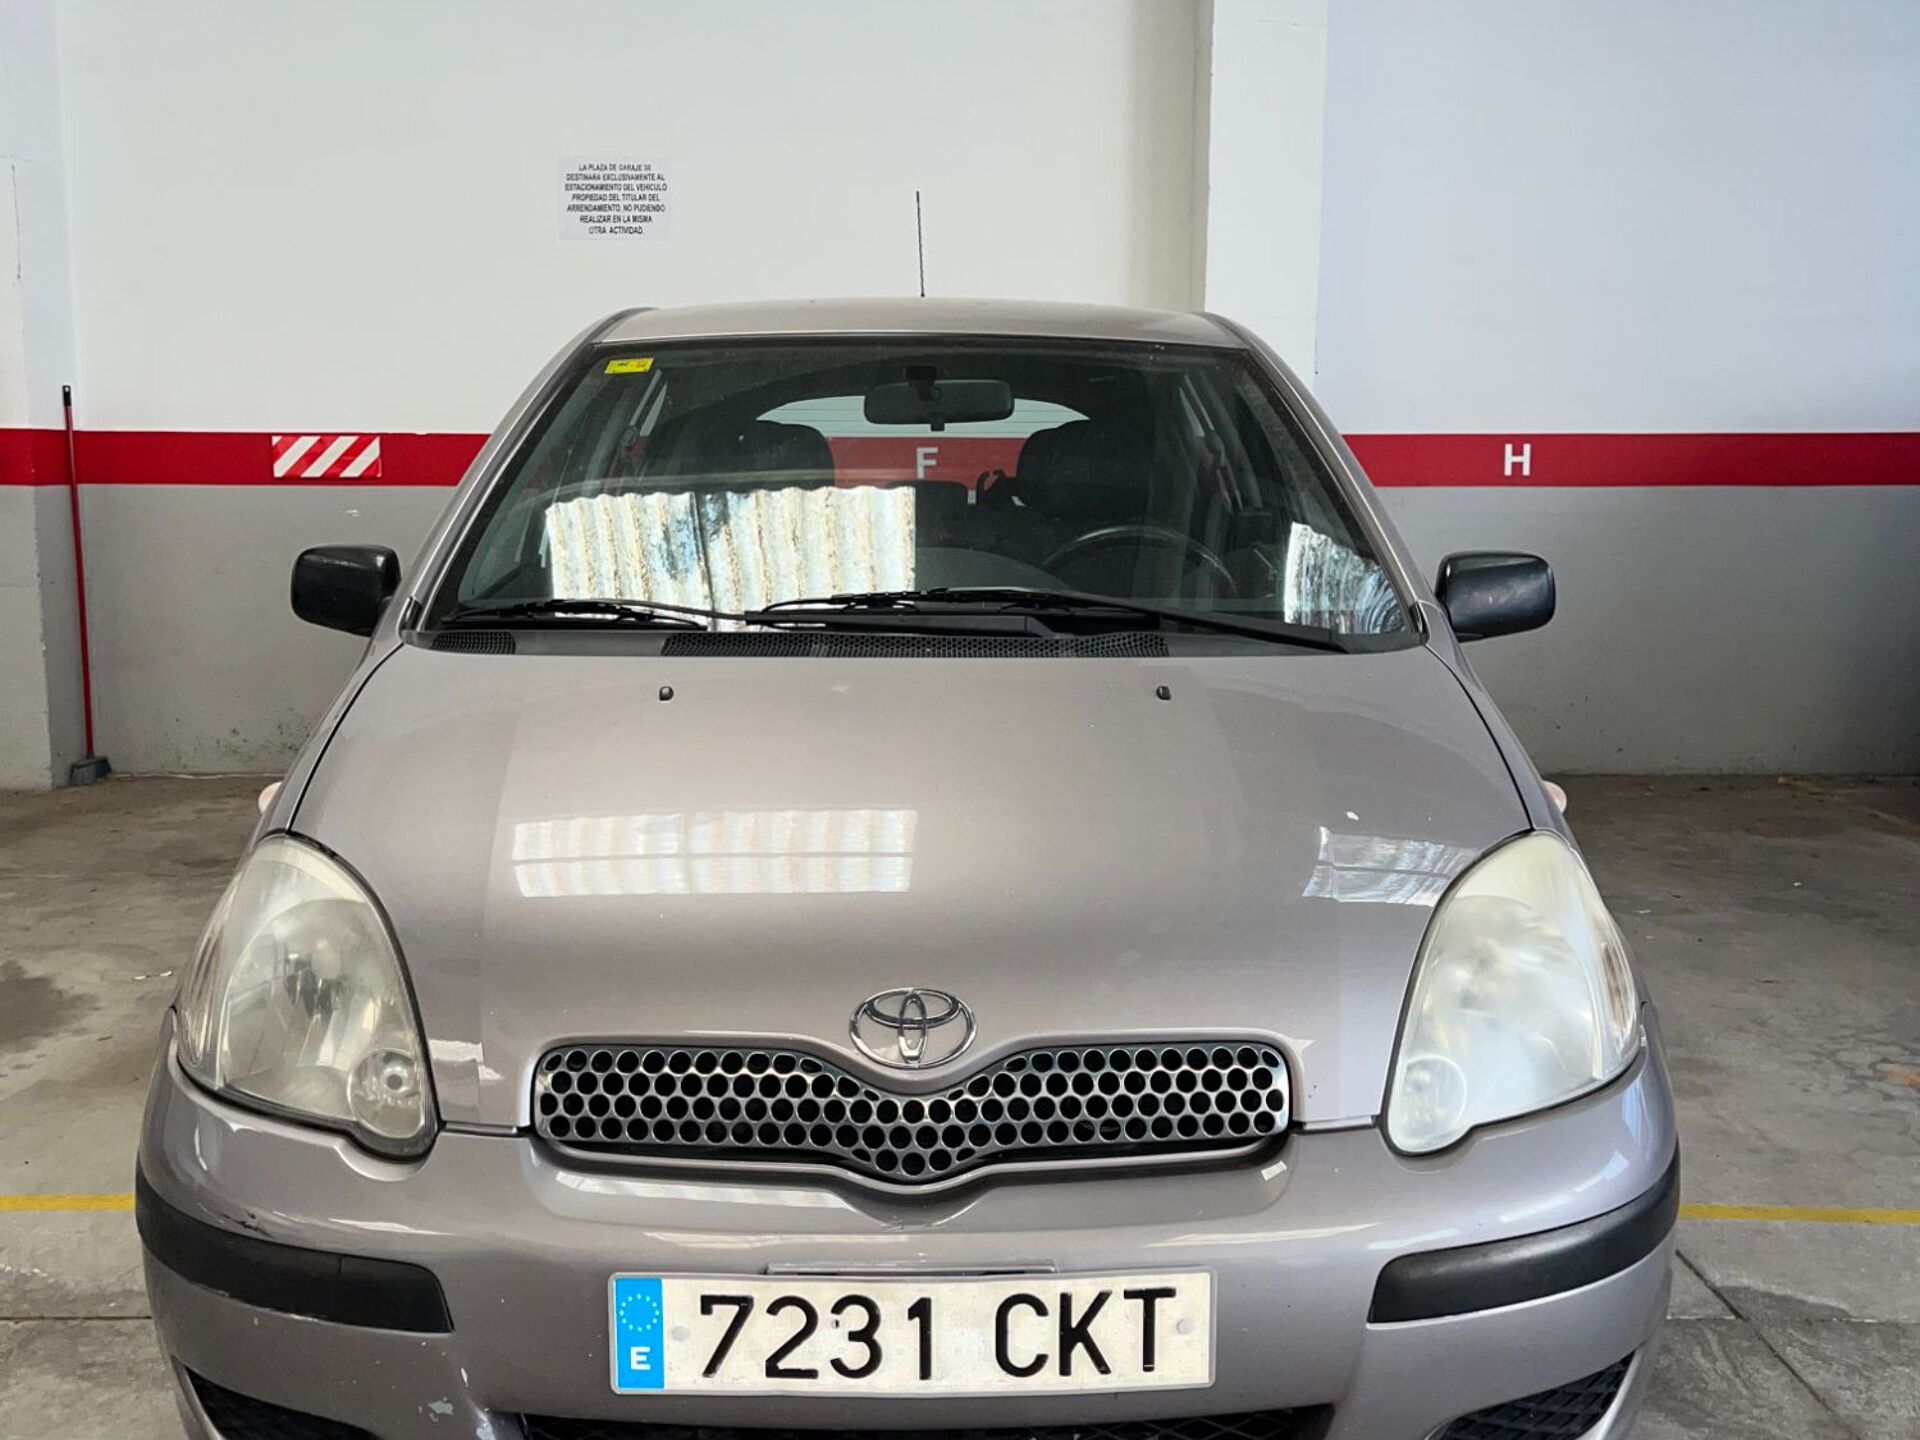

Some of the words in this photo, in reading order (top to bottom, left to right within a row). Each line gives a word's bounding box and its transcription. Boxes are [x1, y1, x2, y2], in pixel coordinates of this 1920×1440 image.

[602, 173, 655, 181] EXCLUSIVAMENTE
[657, 173, 665, 181] AL
[565, 183, 622, 191] ESTACIONAMIENTO
[623, 183, 635, 191] DEL
[623, 204, 632, 212] NO
[633, 204, 666, 212] PUDIENDO
[580, 215, 611, 223] REALIZAR
[613, 215, 621, 223] EN
[623, 215, 631, 223] LA
[632, 215, 652, 223] MISMA
[588, 226, 606, 234] OTRA
[917, 447, 938, 479] F
[1504, 443, 1531, 476] H
[700, 1294, 932, 1381] 7231
[995, 1287, 1176, 1378] CKT
[630, 1346, 651, 1370] E
